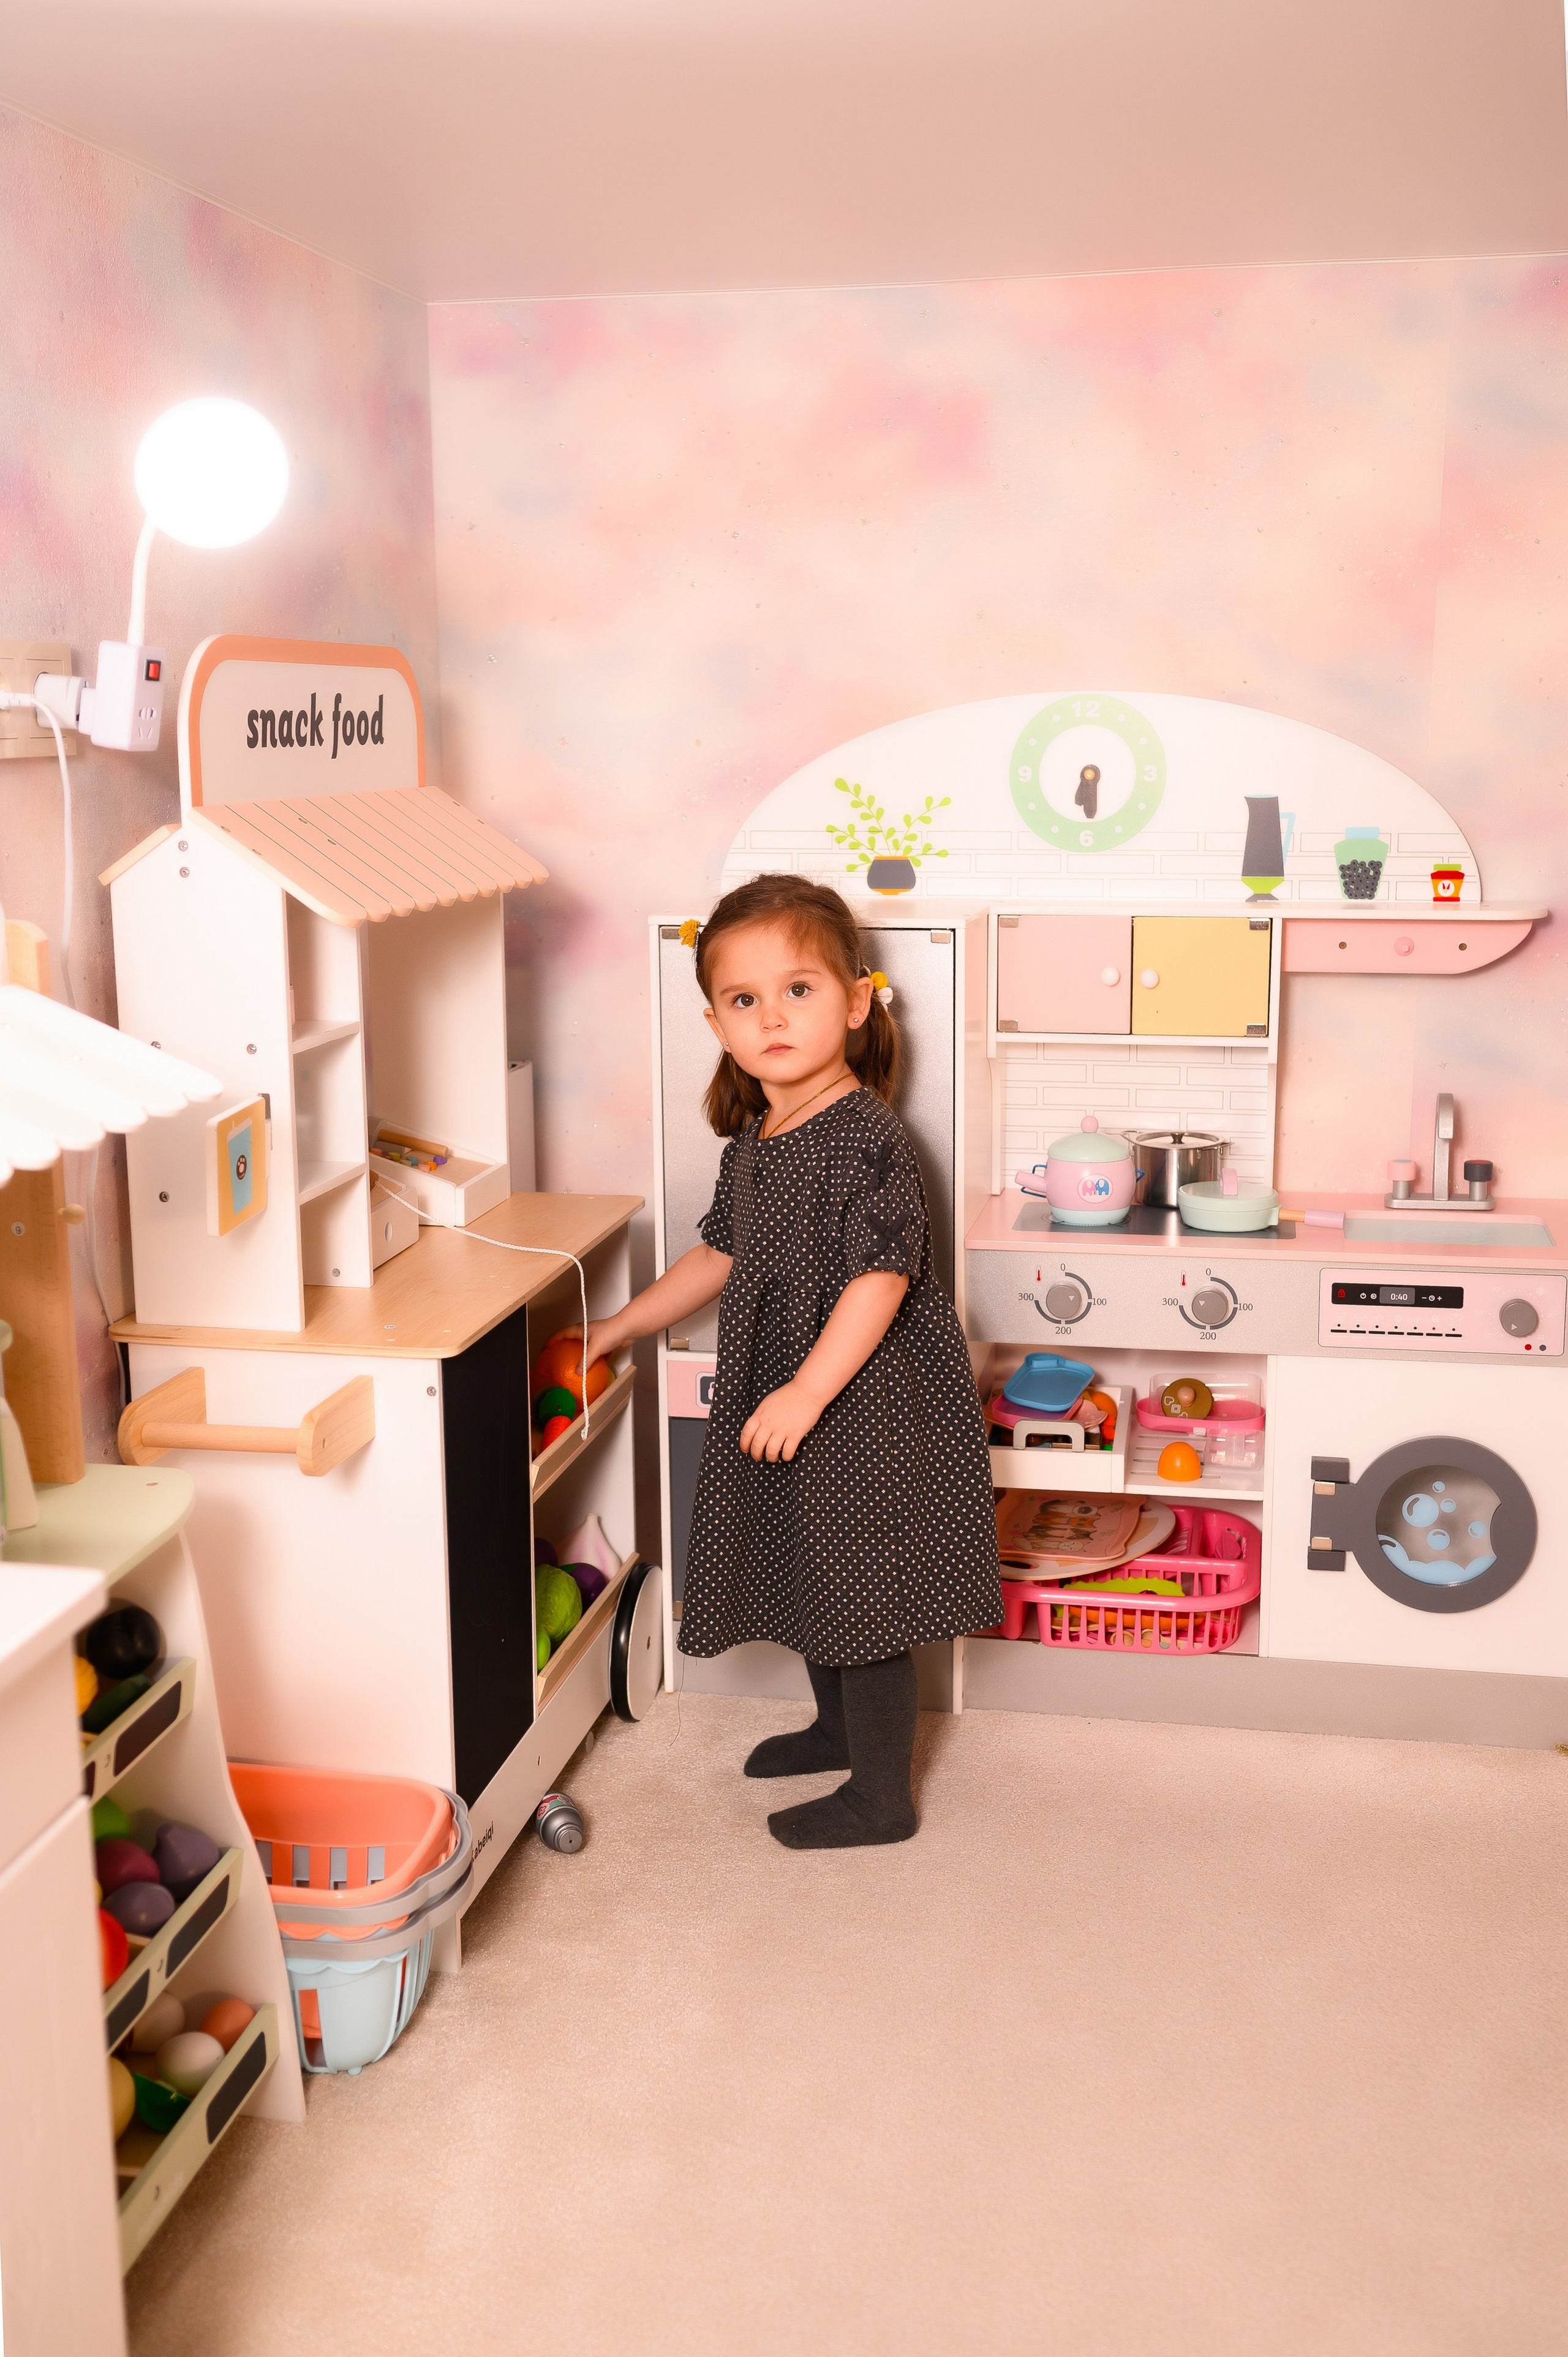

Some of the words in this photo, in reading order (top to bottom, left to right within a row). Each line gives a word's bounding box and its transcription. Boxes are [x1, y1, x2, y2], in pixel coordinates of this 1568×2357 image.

[1072, 700, 1100, 717] 12
[247, 692, 324, 749] snack
[331, 693, 384, 759] food
[1017, 766, 1032, 782] 9
[1143, 765, 1157, 781] 3
[1079, 830, 1094, 847] 6
[1018, 1292, 1034, 1301] 300
[1092, 1297, 1107, 1306] 100
[1162, 1298, 1178, 1307] 300
[1238, 1303, 1253, 1311] 100
[1055, 1326, 1072, 1335] 200
[1199, 1332, 1216, 1340] 200
